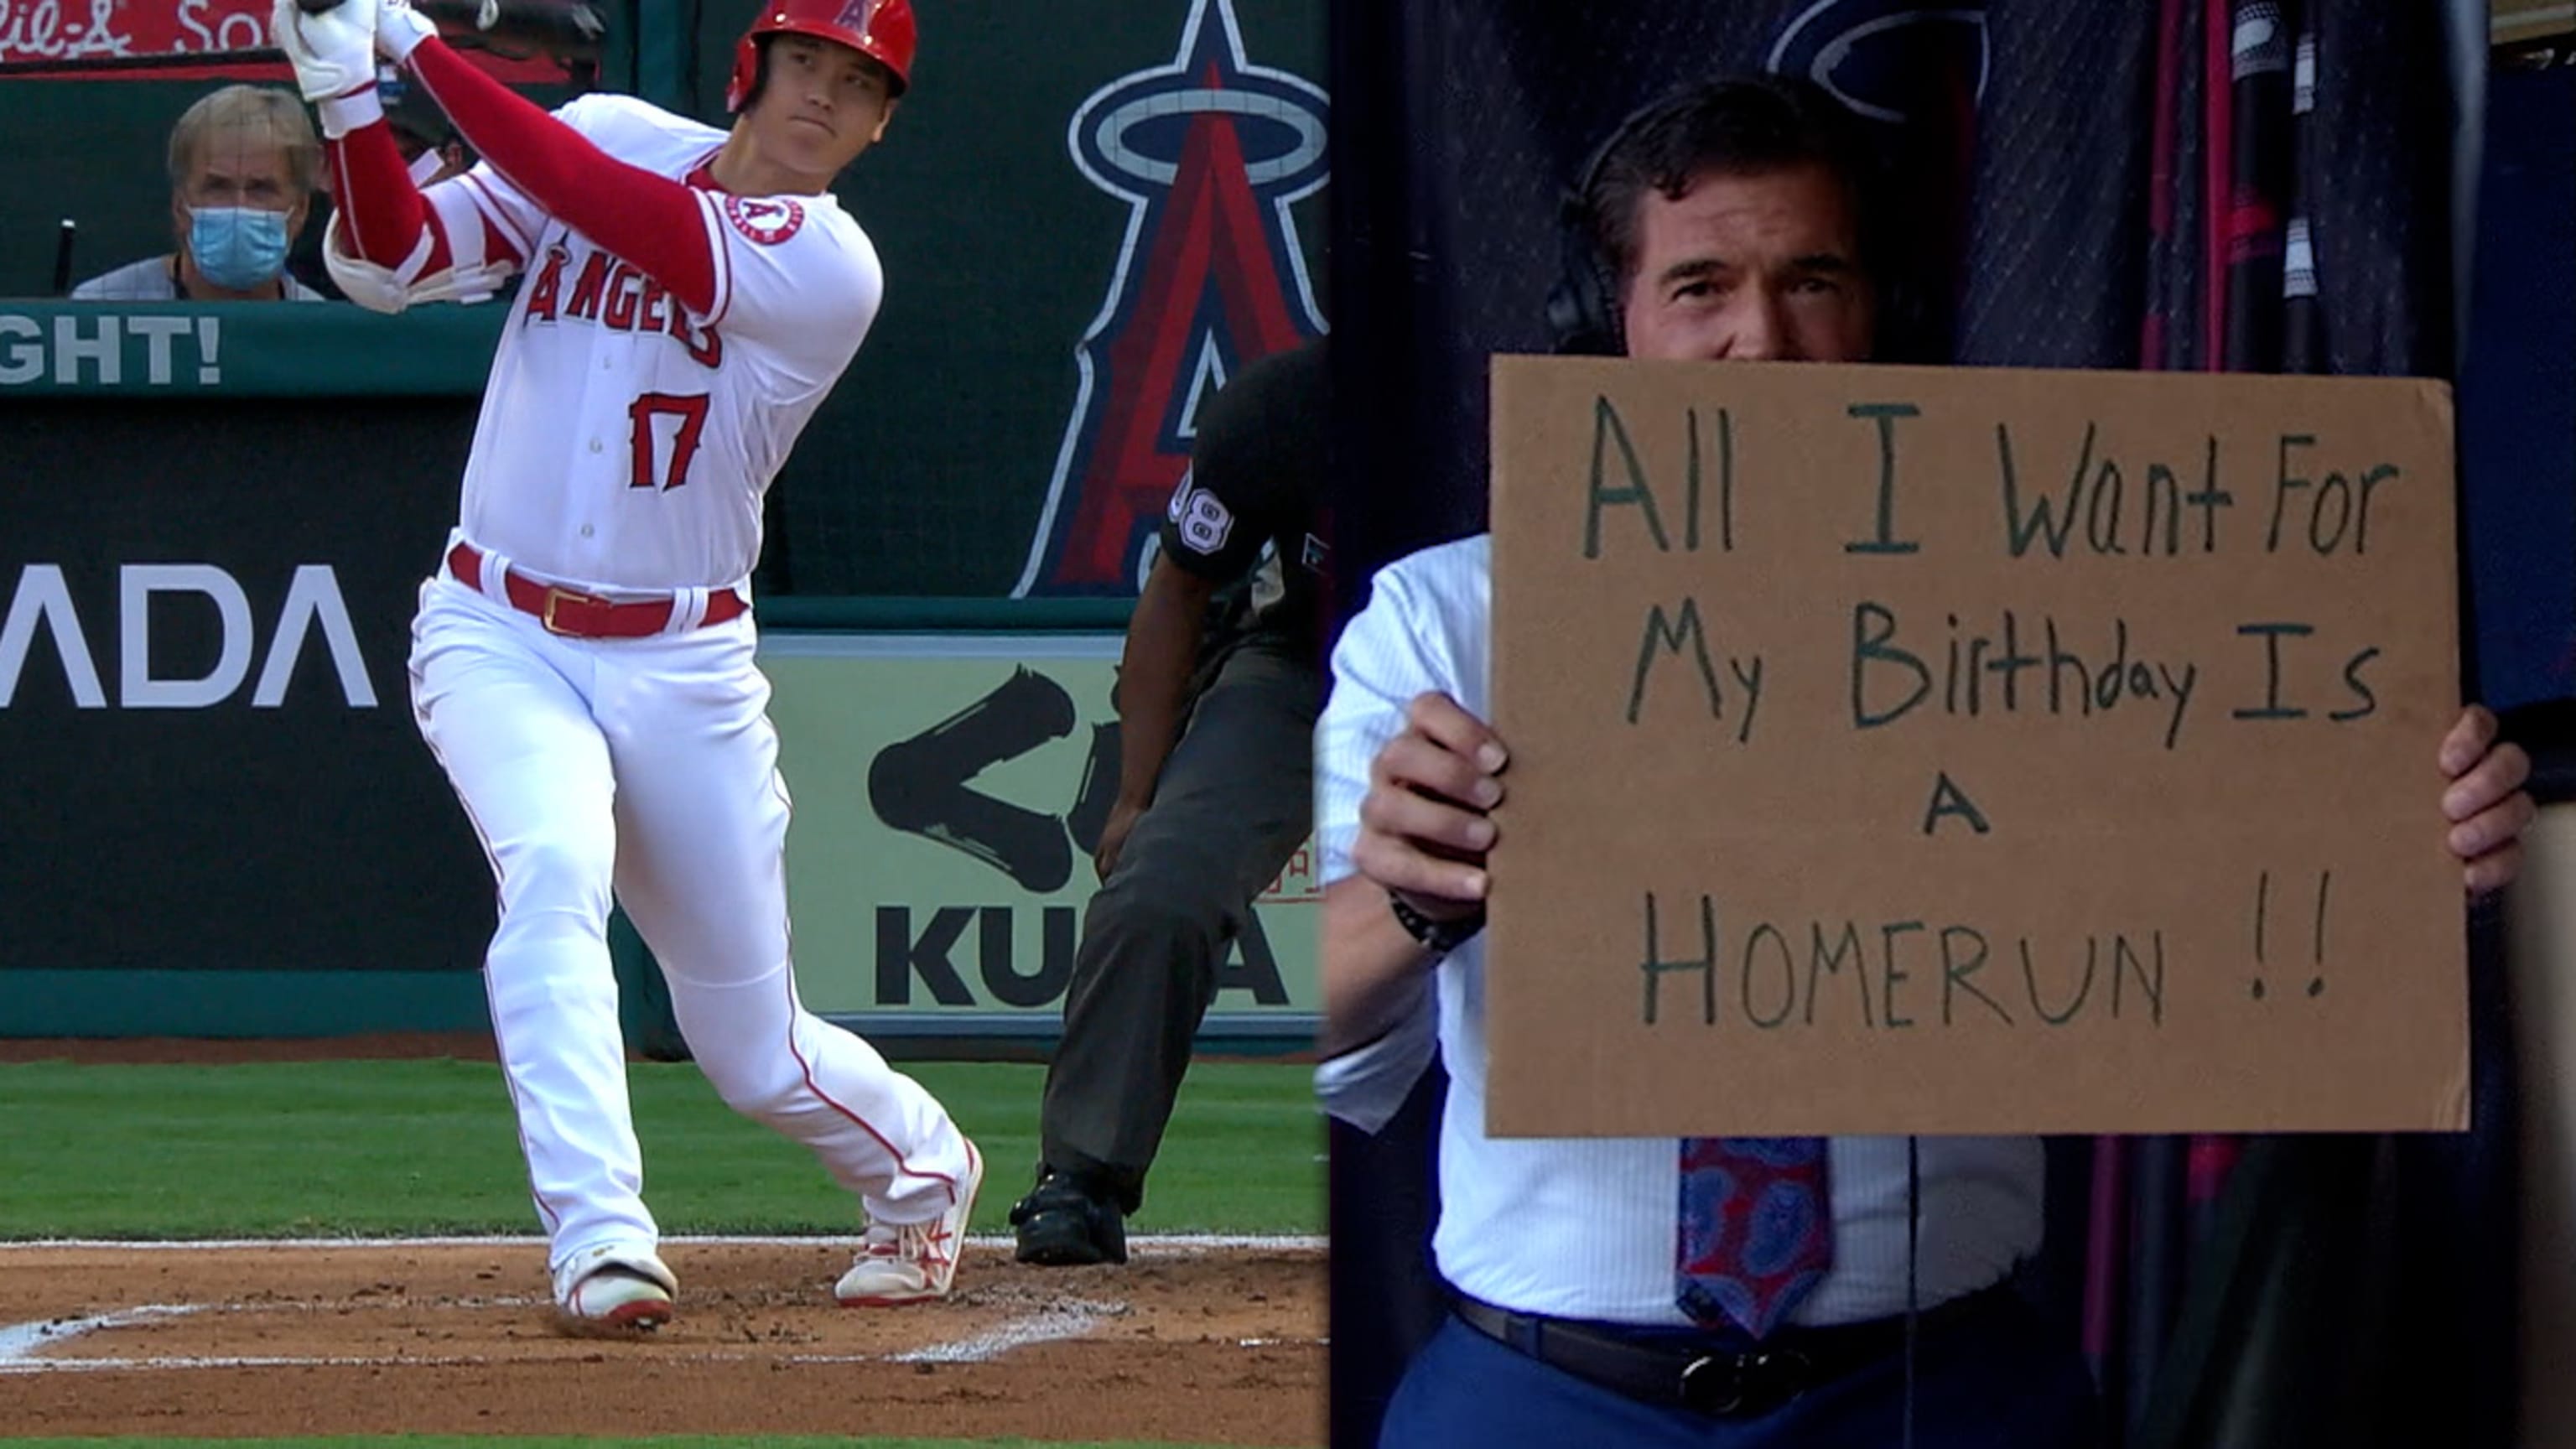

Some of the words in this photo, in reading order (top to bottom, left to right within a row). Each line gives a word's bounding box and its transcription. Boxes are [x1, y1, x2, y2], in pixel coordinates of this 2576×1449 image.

[0, 314, 221, 384] GHT!
[628, 391, 710, 492] 17
[1584, 394, 1734, 559] All
[1844, 402, 1921, 554] I
[1997, 421, 2234, 558] Want
[2267, 434, 2400, 556] For
[1628, 597, 1762, 743] My
[1852, 601, 2196, 750] Birthday
[2232, 623, 2381, 723] Is
[1924, 771, 1990, 835] A
[875, 906, 1291, 1007] KUA
[1641, 891, 2163, 1029] HOMERUN
[2251, 870, 2330, 1000] !!
